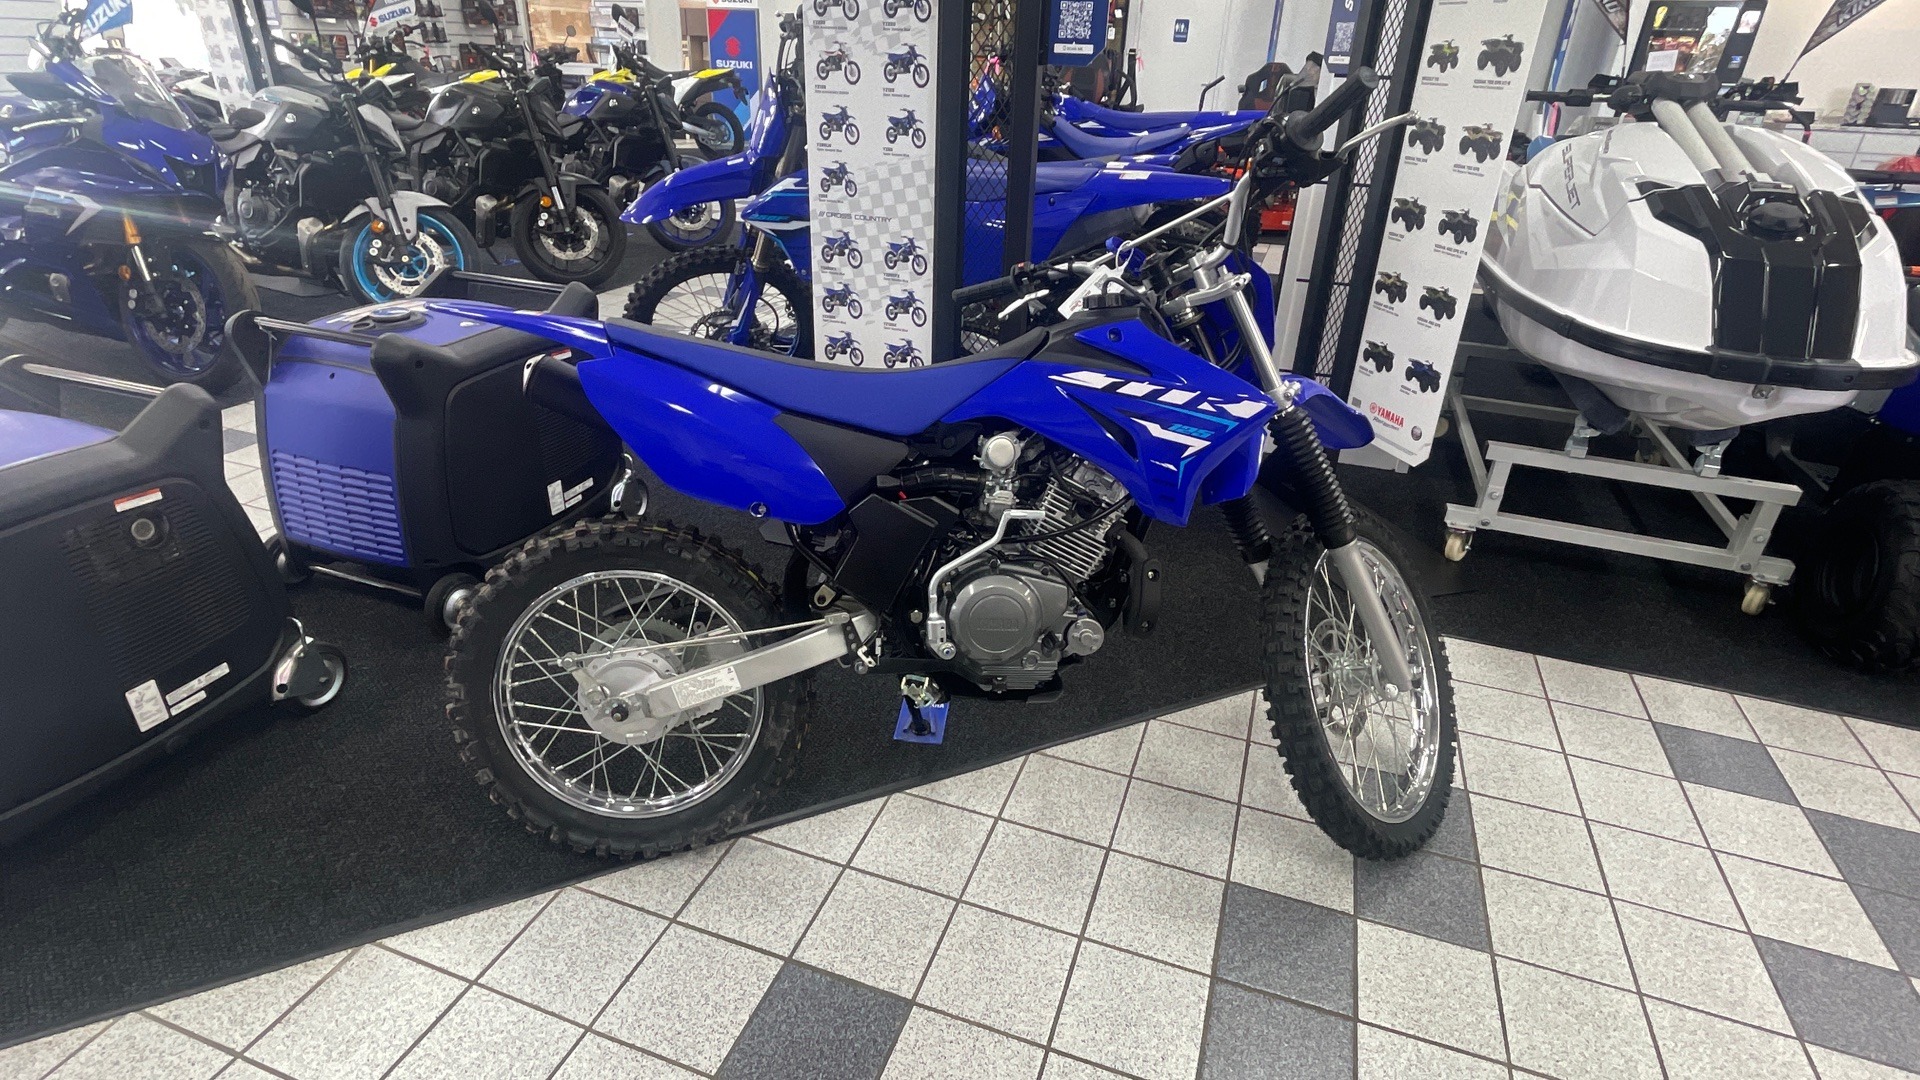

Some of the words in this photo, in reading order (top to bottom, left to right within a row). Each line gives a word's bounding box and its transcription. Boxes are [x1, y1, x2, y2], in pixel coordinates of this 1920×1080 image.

[378, 6, 411, 23] SUZUKI
[716, 59, 753, 69] SUZUKI
[826, 211, 852, 220] CROSS
[854, 214, 892, 222] COUNTRY
[1378, 406, 1404, 428] YAMAHA
[1167, 423, 1215, 439] 125
